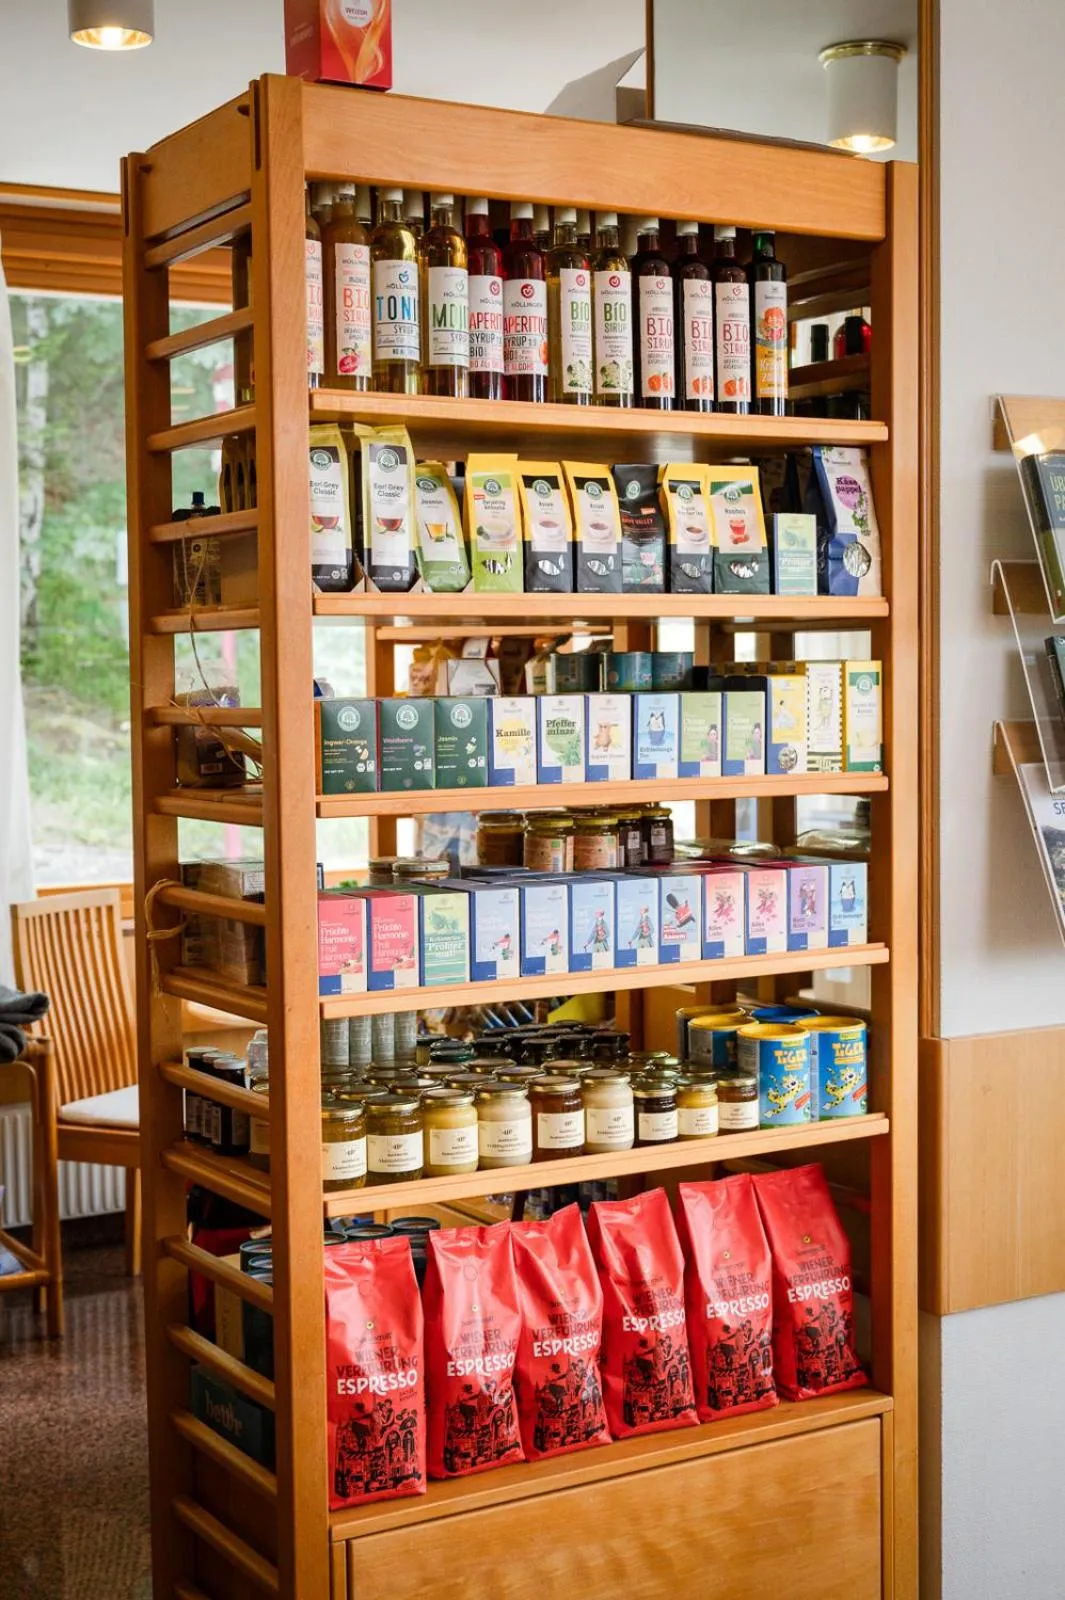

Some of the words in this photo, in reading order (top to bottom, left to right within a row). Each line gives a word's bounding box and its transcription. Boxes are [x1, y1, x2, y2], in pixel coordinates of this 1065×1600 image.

[646, 317, 673, 337] BIO
[313, 487, 337, 496] Classic
[322, 481, 339, 490] Grey
[373, 482, 388, 490] Earl
[387, 483, 404, 492] Grey
[377, 490, 401, 499] Classic
[545, 719, 576, 729] Pfeffer
[495, 728, 531, 738] Kamille
[546, 728, 575, 736] minze
[787, 1275, 851, 1304] ESPRESSO
[706, 1292, 770, 1320] ESPRESSO
[622, 1307, 686, 1335] ESPRESSO
[532, 1330, 600, 1358] ESPRESSO
[446, 1351, 516, 1378] ESPRESSO
[336, 1369, 418, 1397] ESPRESSO
